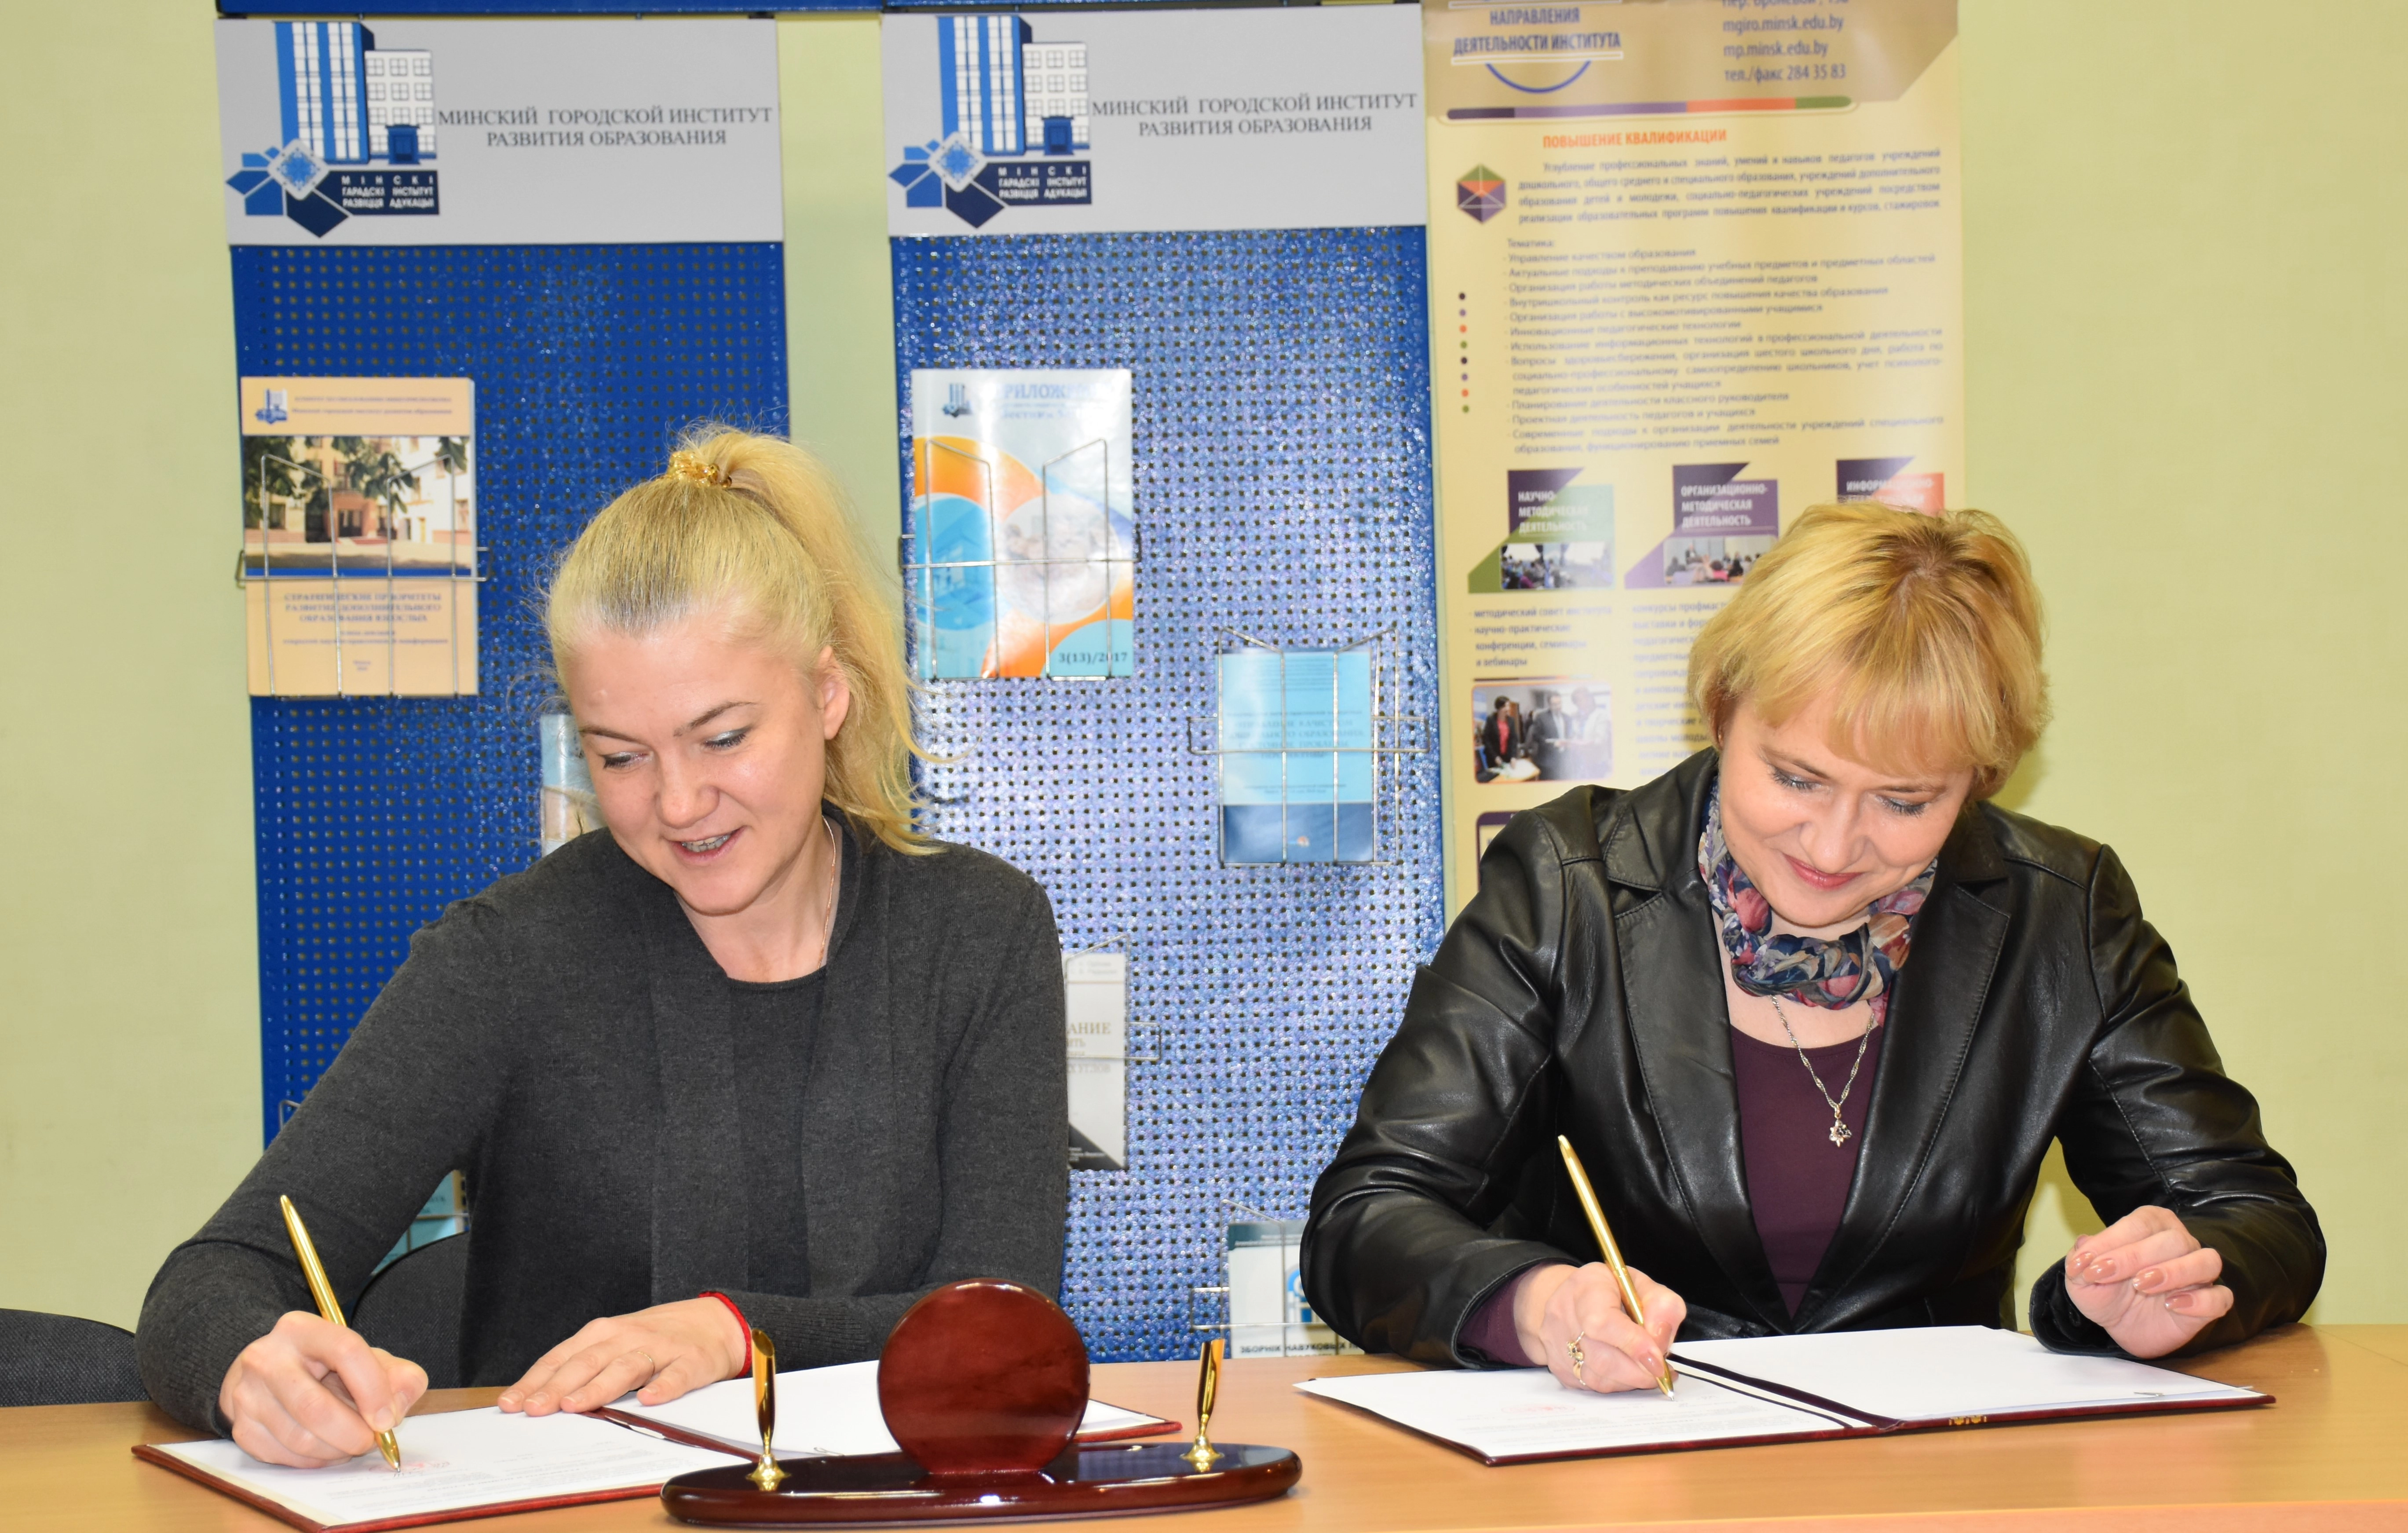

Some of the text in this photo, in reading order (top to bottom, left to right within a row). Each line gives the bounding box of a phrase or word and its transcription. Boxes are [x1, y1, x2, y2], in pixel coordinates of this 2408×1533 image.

[1490, 7, 1580, 26] НАПРАВЛЕНИЯ
[1722, 14, 1844, 35] mgiro.minsk.edu.by
[1453, 33, 1621, 56] ДЕЯТЕЛЬНОСТИ ИНСТИТУТА
[1724, 40, 1829, 60] mp.minsk.edu.by
[1725, 63, 1846, 84] тел./факс 284 35 83
[1092, 93, 1418, 116] МИНСКИЙ ГОРОДСКОЙ ИНСТИТУТ
[438, 106, 772, 126] МИНСКИЙ ГОРОДСКОЙ ИНСТИТУТ
[1139, 116, 1372, 136] РАЗВИТИЯ ОБРАЗОВАНИЯ
[487, 129, 727, 146] РАЗВИТИЯ ОБРАЗОВАНИЯ
[1543, 129, 1727, 148] ПОВЫШЕНИЕ КВАЛИФИКАЦИИ
[1681, 483, 1768, 497] ОРГАНИЗАЦИОННО-
[1681, 499, 1753, 512] МЕТОДИЧЕСКАЯ
[1682, 514, 1752, 529] ДЕЯТЕЛЬНОСТЬ
